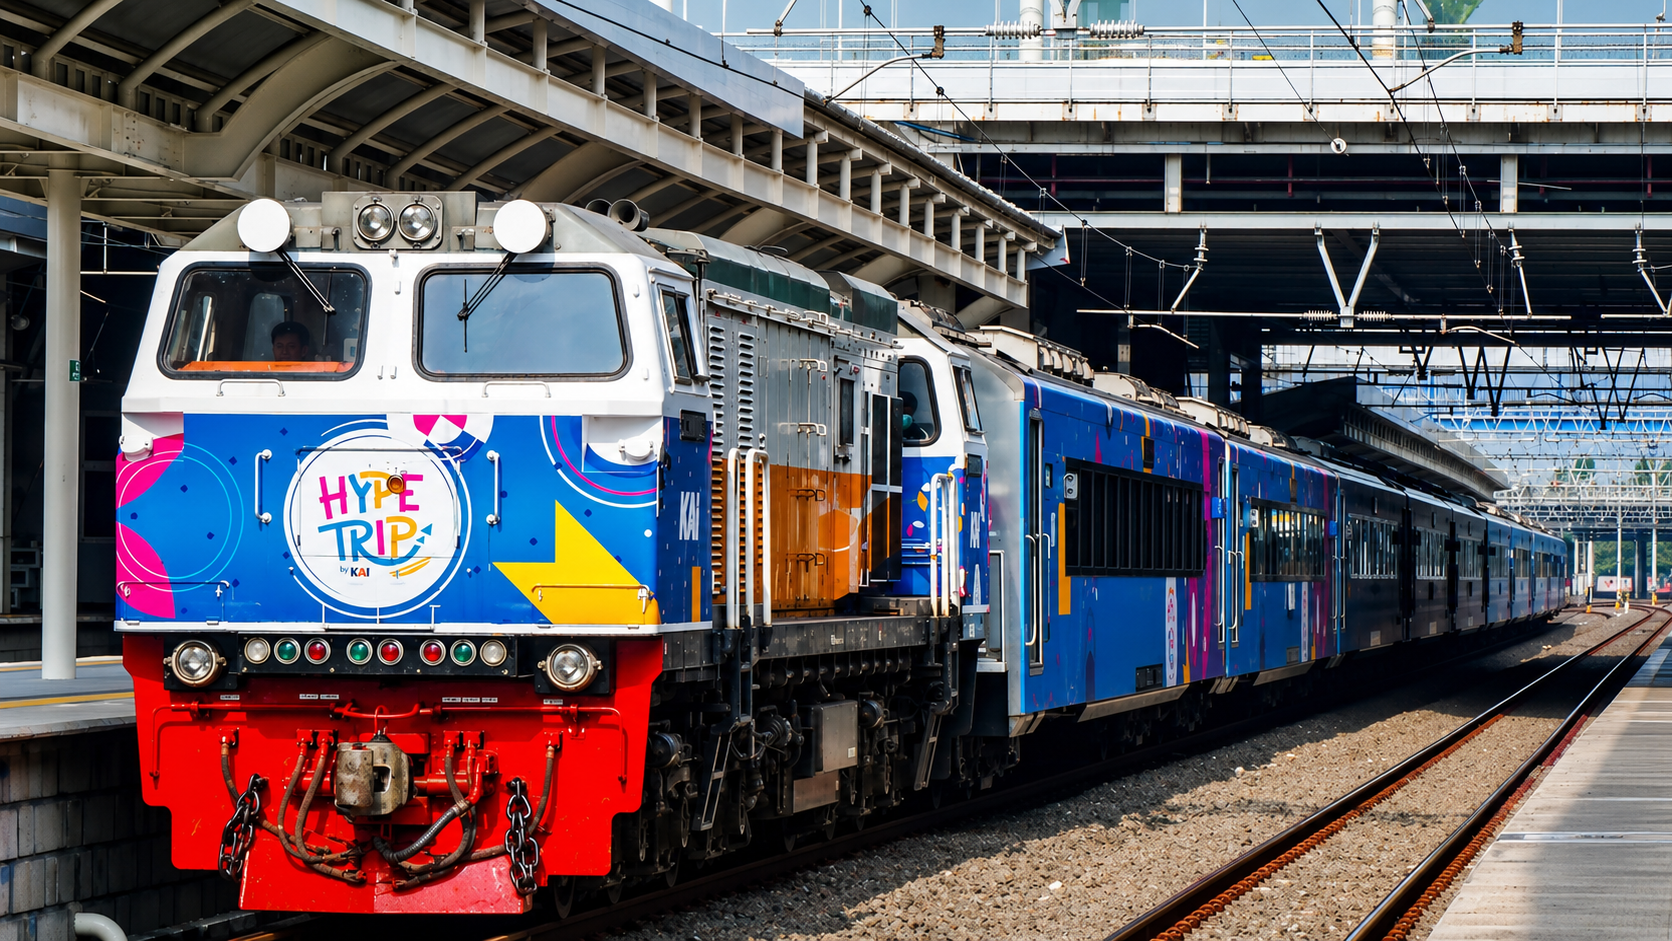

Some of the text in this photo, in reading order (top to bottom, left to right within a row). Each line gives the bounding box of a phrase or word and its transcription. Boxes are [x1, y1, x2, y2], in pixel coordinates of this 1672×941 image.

[319, 471, 423, 520] HYPE
[679, 491, 700, 540] KAI
[317, 516, 421, 566] TRIP
[340, 566, 370, 577] by KAI
